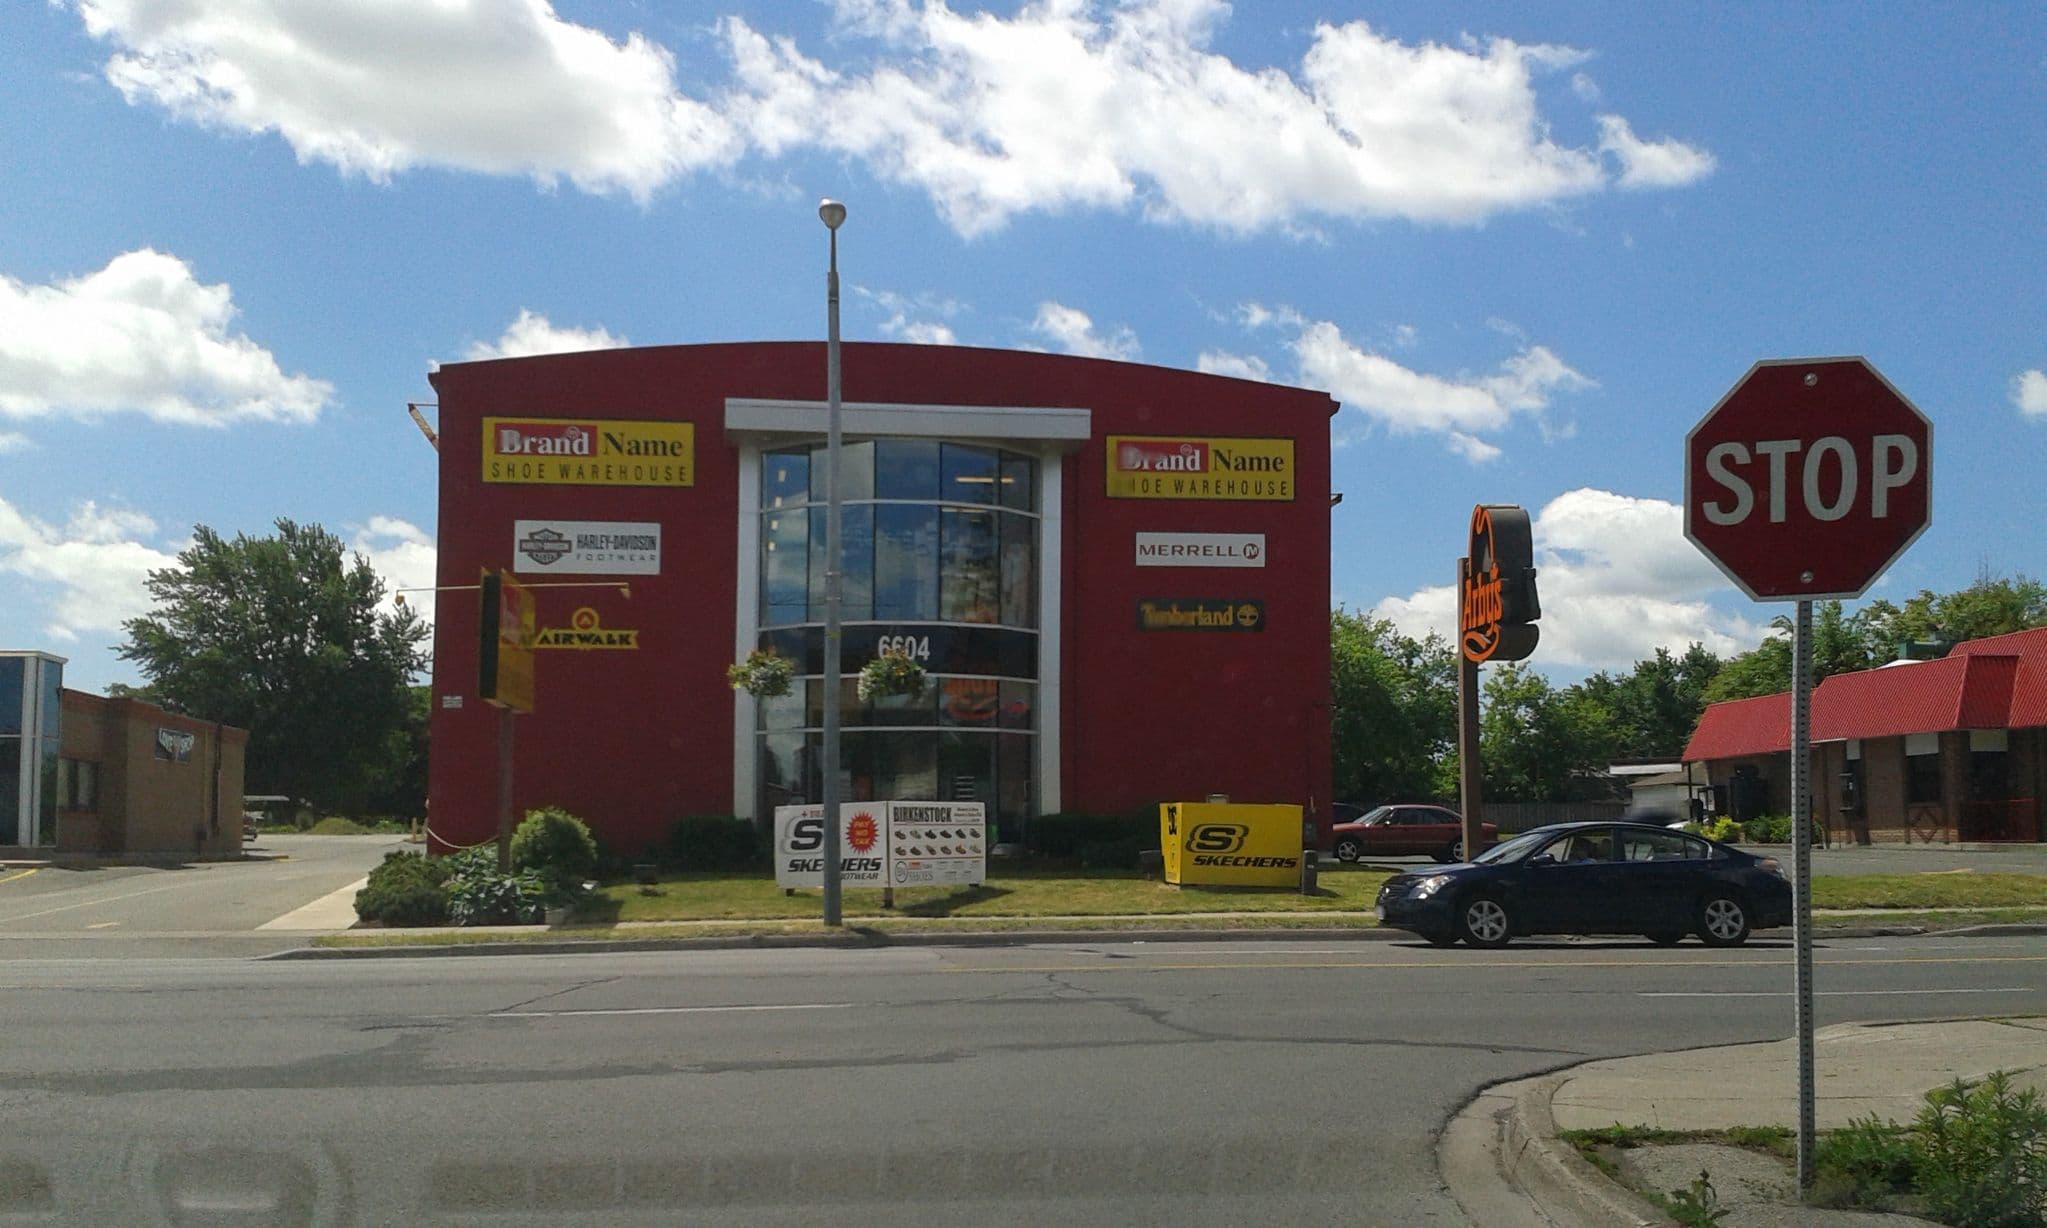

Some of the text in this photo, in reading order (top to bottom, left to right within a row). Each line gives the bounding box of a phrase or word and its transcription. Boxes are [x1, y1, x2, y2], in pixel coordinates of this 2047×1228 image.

[500, 429, 683, 456] Brand Name
[1213, 449, 1285, 472] Name
[492, 462, 687, 482] SHOE WAREHOUSE
[1702, 434, 1918, 526] STOP
[1174, 479, 1287, 496] WAREHOUSE
[576, 534, 657, 551] HARLEY-DAVIDSON
[1139, 544, 1240, 557] MERRELL
[1140, 602, 1234, 627] Timberland
[538, 633, 632, 646] AIRWALK
[878, 636, 930, 661] 6604
[893, 806, 953, 823] BIRKENSTOCK
[1193, 855, 1298, 868] SKECHERS
